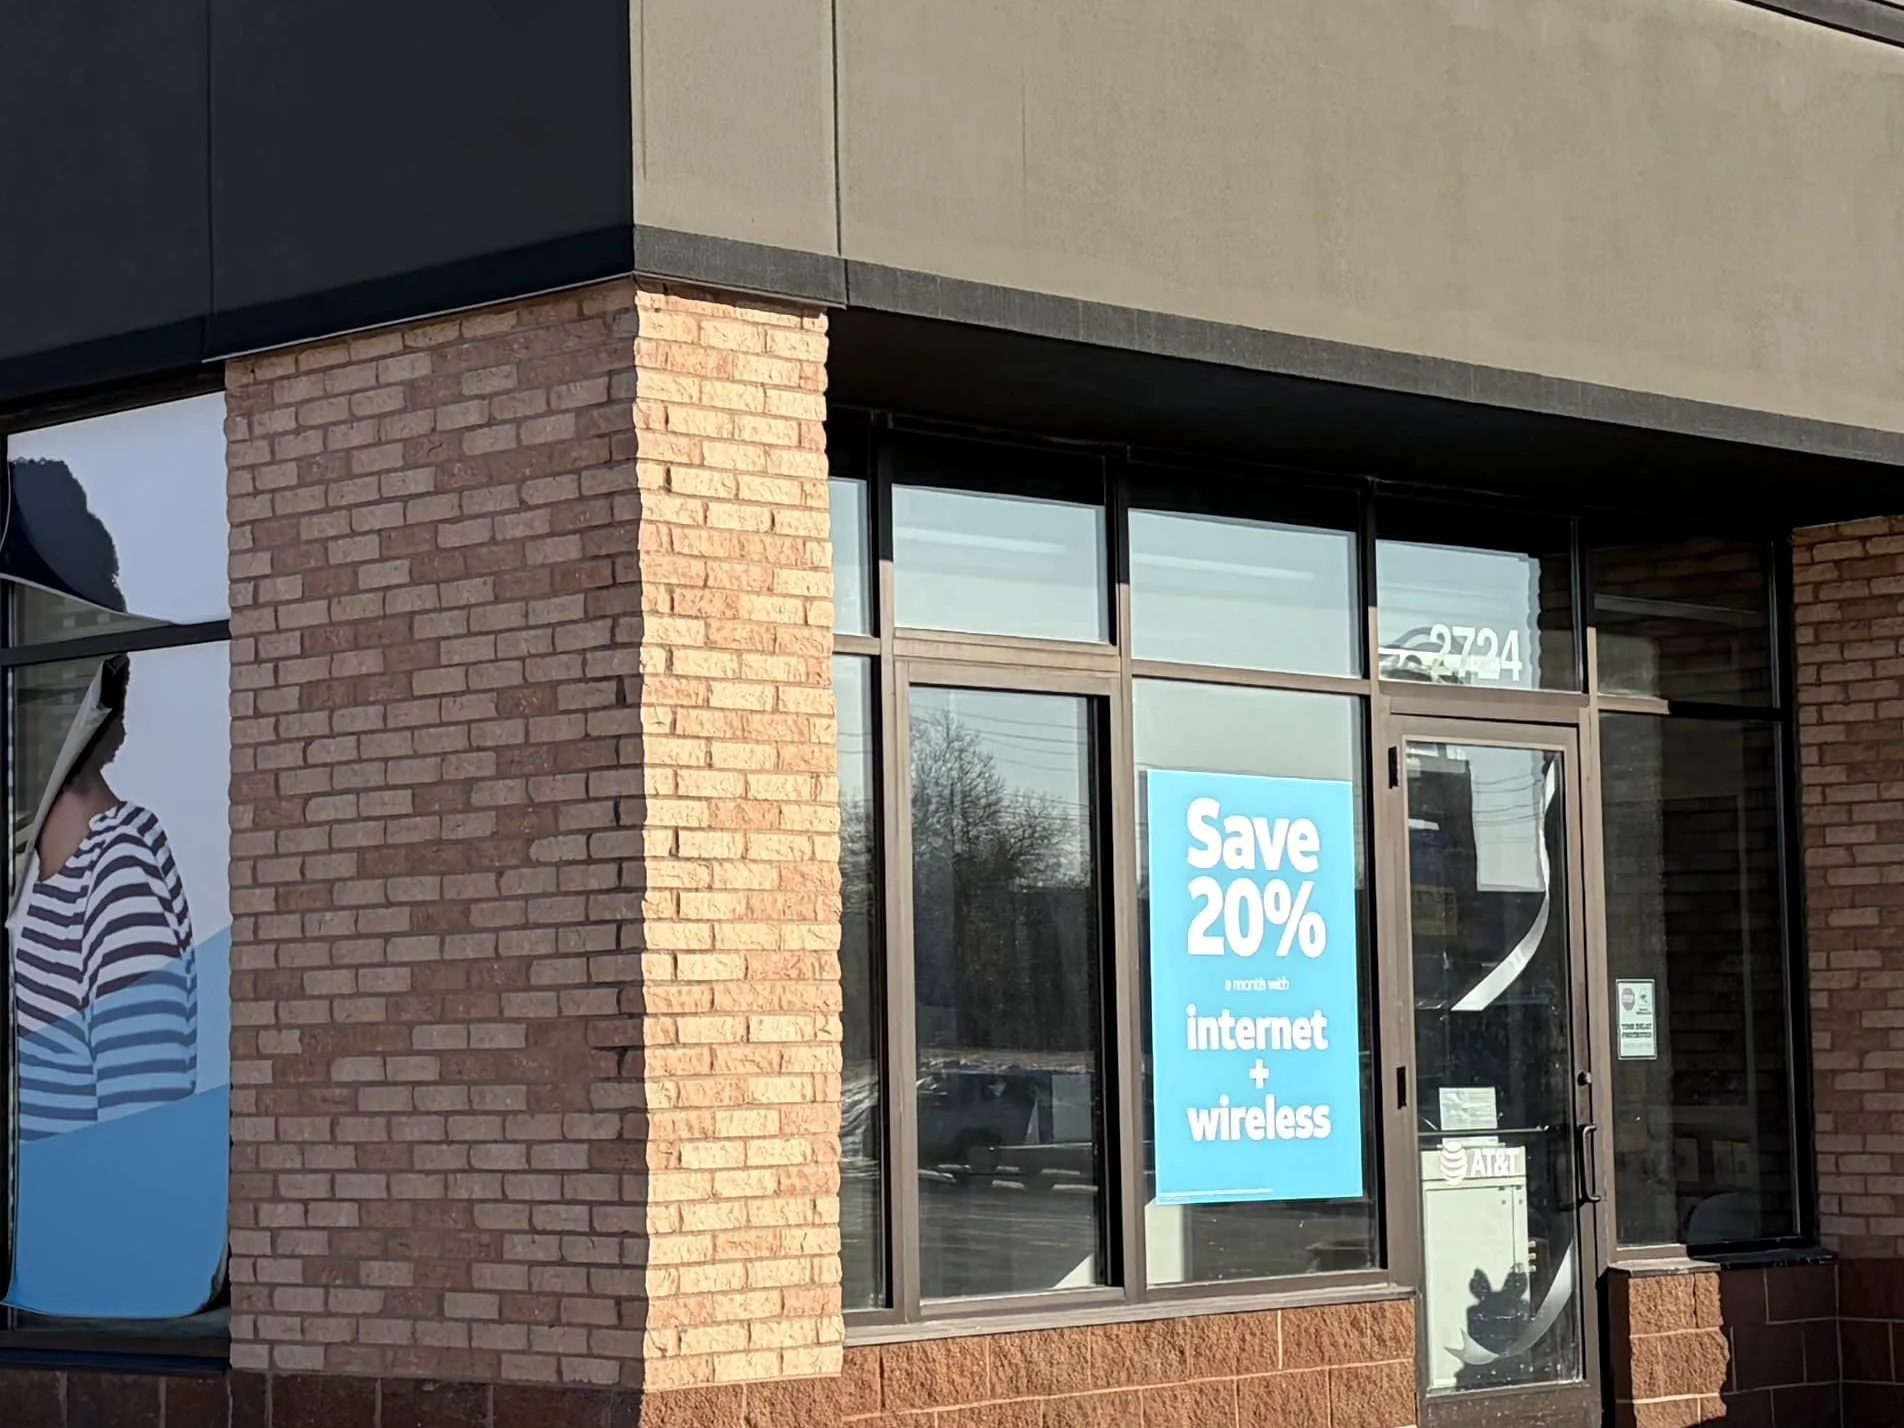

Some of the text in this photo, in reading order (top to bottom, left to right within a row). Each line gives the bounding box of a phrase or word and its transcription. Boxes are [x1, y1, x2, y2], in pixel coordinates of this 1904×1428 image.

[1430, 623, 1523, 682] 2724
[1185, 796, 1321, 872] Save
[1186, 875, 1328, 959] 20%
[1185, 1003, 1329, 1051] internet
[1187, 1094, 1333, 1142] wireless
[1470, 1147, 1518, 1178] AT&T
